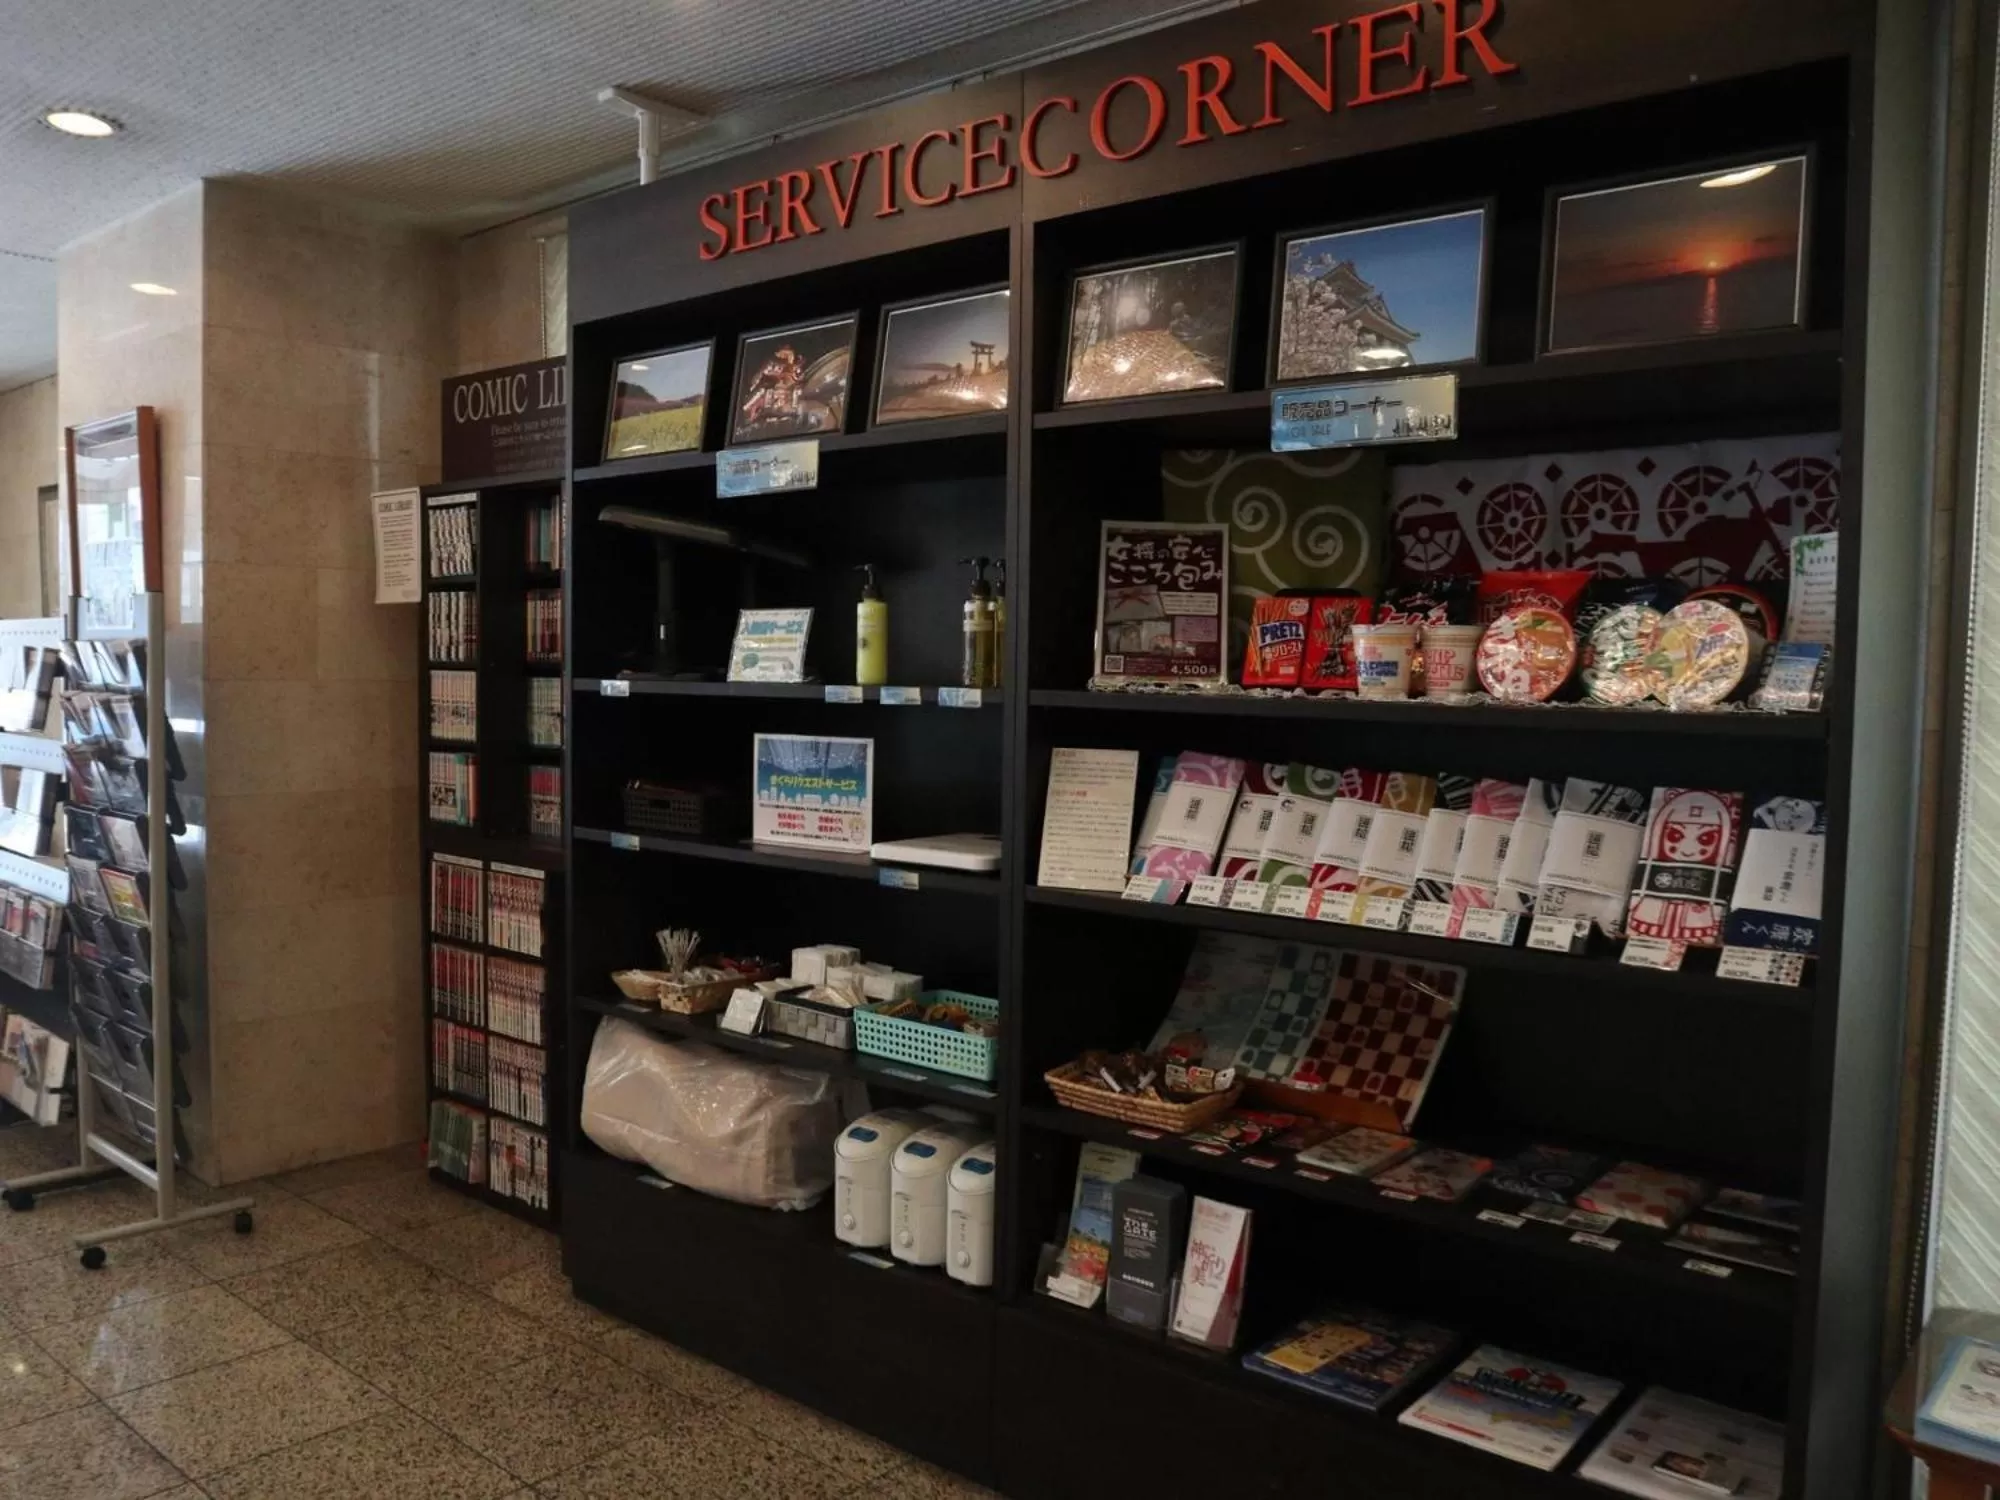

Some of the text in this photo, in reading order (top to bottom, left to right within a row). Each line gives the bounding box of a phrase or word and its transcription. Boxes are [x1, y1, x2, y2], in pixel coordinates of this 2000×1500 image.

[454, 373, 528, 423] COMIC
[1108, 560, 1225, 590] こころ包み
